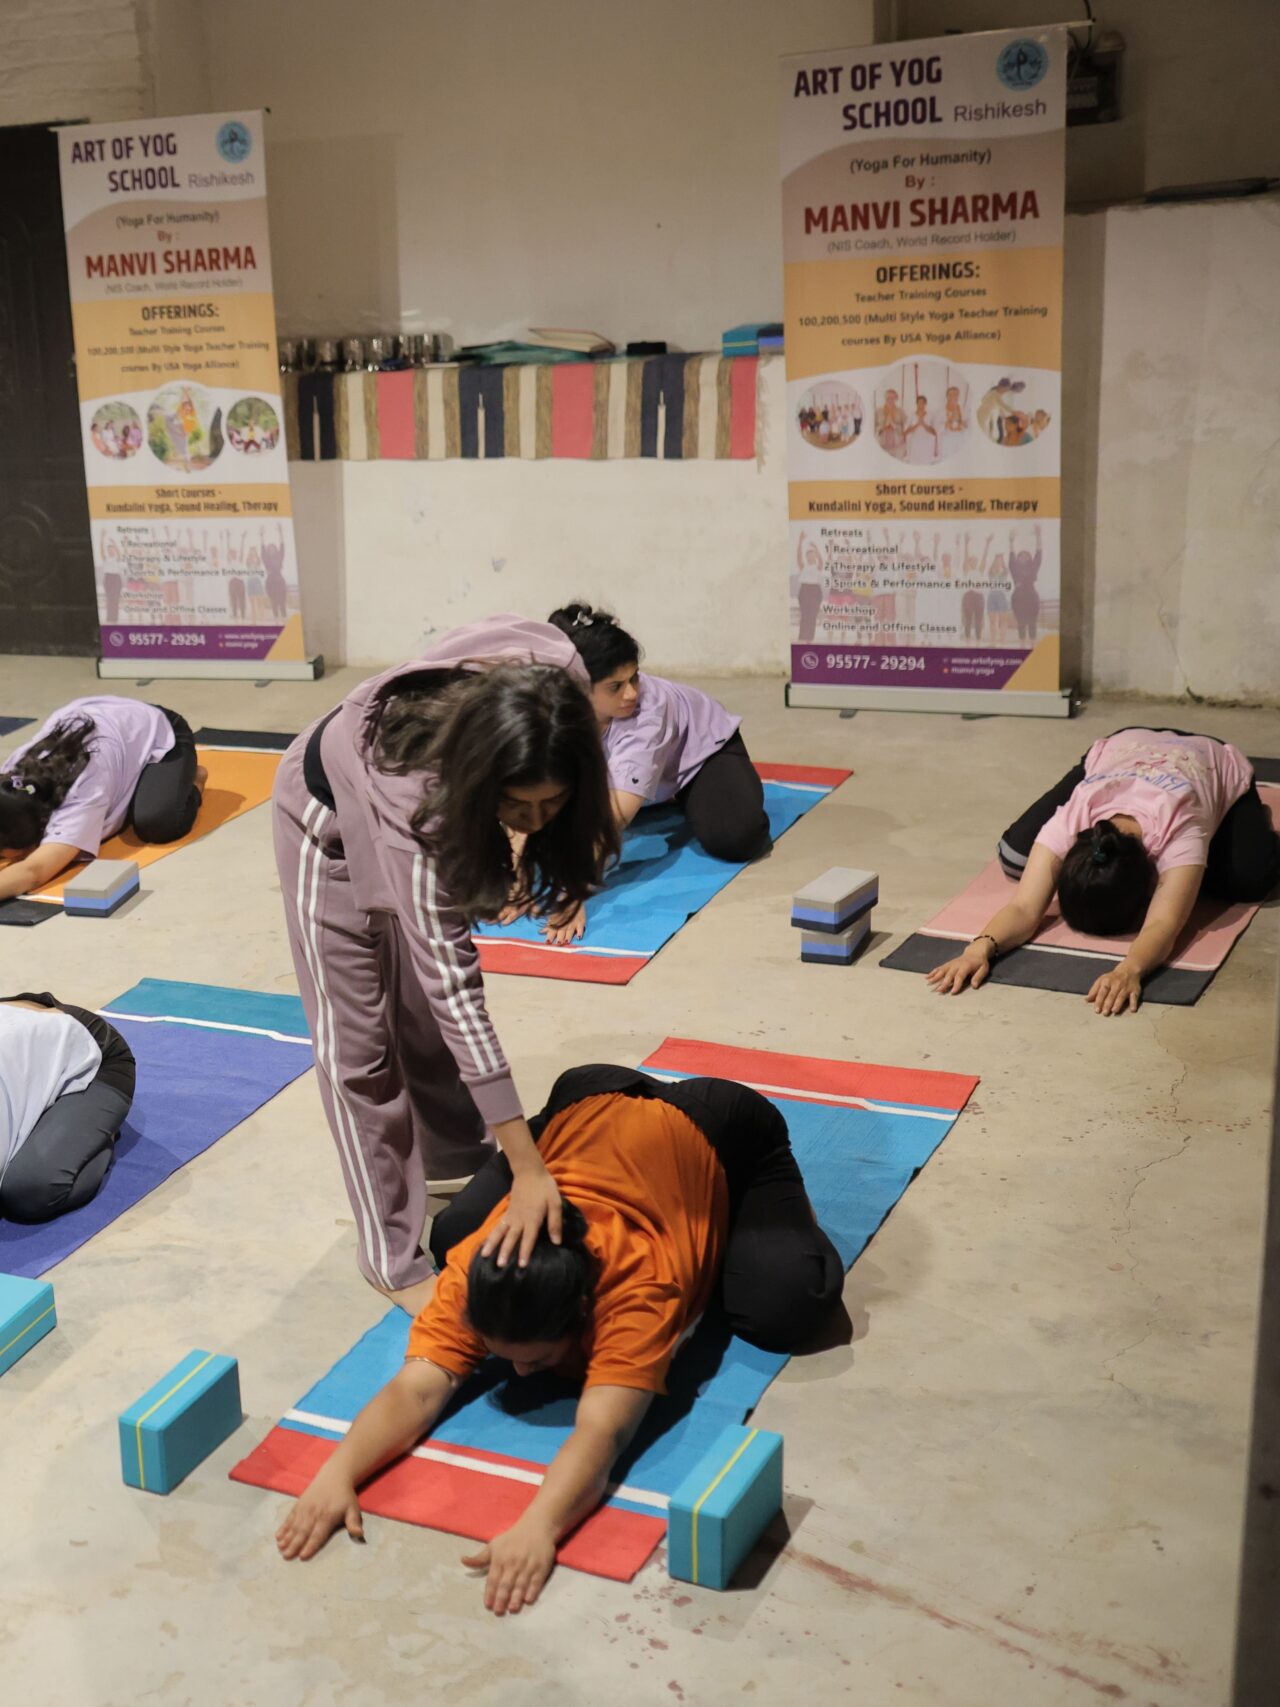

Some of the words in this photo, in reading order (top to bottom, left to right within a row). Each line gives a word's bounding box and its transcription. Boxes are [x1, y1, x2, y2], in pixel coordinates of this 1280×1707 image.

[794, 67, 843, 97] ART
[851, 62, 882, 90] OF
[890, 56, 942, 88] YOG
[843, 96, 942, 131] SCHOOL
[954, 99, 1047, 122] Rishikesh
[71, 139, 106, 163] ART
[112, 137, 134, 159] OF
[140, 133, 177, 157] YOG
[850, 157, 888, 173] (Yoga
[893, 155, 915, 168] For
[920, 149, 991, 166] Humanity)
[108, 166, 180, 192] SCHOOL
[188, 172, 255, 188] Rishikesh
[905, 174, 926, 188] By
[804, 201, 900, 234] MANVI
[910, 190, 1039, 227] SHARMA
[116, 216, 144, 229] (Yoga
[147, 214, 164, 224] For
[167, 210, 220, 224] Humanity)
[157, 230, 172, 243] By
[854, 238, 893, 250] Coach,
[897, 235, 927, 247] World
[931, 232, 971, 245] Record
[974, 230, 1016, 244] Holder)
[85, 252, 156, 278] MANVI
[163, 246, 256, 273] SHARMA
[876, 262, 980, 283] OFFERINGS:
[855, 292, 895, 303] Teacher
[900, 289, 941, 302] Training
[945, 287, 986, 298] Courses
[142, 304, 219, 320] OFFERINGS:
[864, 312, 897, 325] (Multi
[900, 311, 925, 324] Style
[929, 310, 954, 322] Yoga
[959, 308, 998, 318] Teacher
[1002, 305, 1048, 317] Training
[161, 326, 192, 335] Training
[194, 325, 225, 333] Courses
[841, 336, 880, 346] courses
[884, 334, 897, 346] By
[900, 333, 921, 344] USA
[926, 332, 951, 344] Yoga
[954, 330, 1001, 341] Alliance)
[165, 362, 180, 370] USA
[156, 489, 179, 498] Short
[181, 488, 215, 497] Courses
[876, 484, 906, 495] Short
[910, 484, 955, 494] Courses
[107, 503, 145, 512] Kundalini
[149, 503, 171, 513] Yoga,
[175, 503, 201, 511] Sound
[204, 502, 240, 512] Healing,
[242, 501, 278, 511] Therapy
[808, 500, 861, 513] Kundalini
[864, 500, 896, 513] Yoga,
[900, 500, 935, 512] Sound
[938, 500, 986, 513] Healing,
[990, 499, 1039, 513] Therapy
[821, 528, 863, 538] Retreats
[833, 545, 898, 554] Recreational
[173, 554, 206, 562] Lifestyle
[222, 569, 265, 577] Enhancing
[833, 562, 875, 572] Therapy
[879, 563, 888, 571] &
[892, 562, 936, 572] Lifestyle
[871, 580, 879, 588] &
[883, 579, 951, 589] Performance
[955, 580, 1012, 590] Enhancing
[198, 606, 226, 614] Classes
[823, 605, 875, 615] Workshop
[823, 622, 857, 632] Online
[859, 623, 879, 632] and
[919, 623, 957, 633] Classes
[171, 633, 205, 646] 29294
[826, 654, 877, 668] 95577-
[881, 655, 925, 671] 29294
